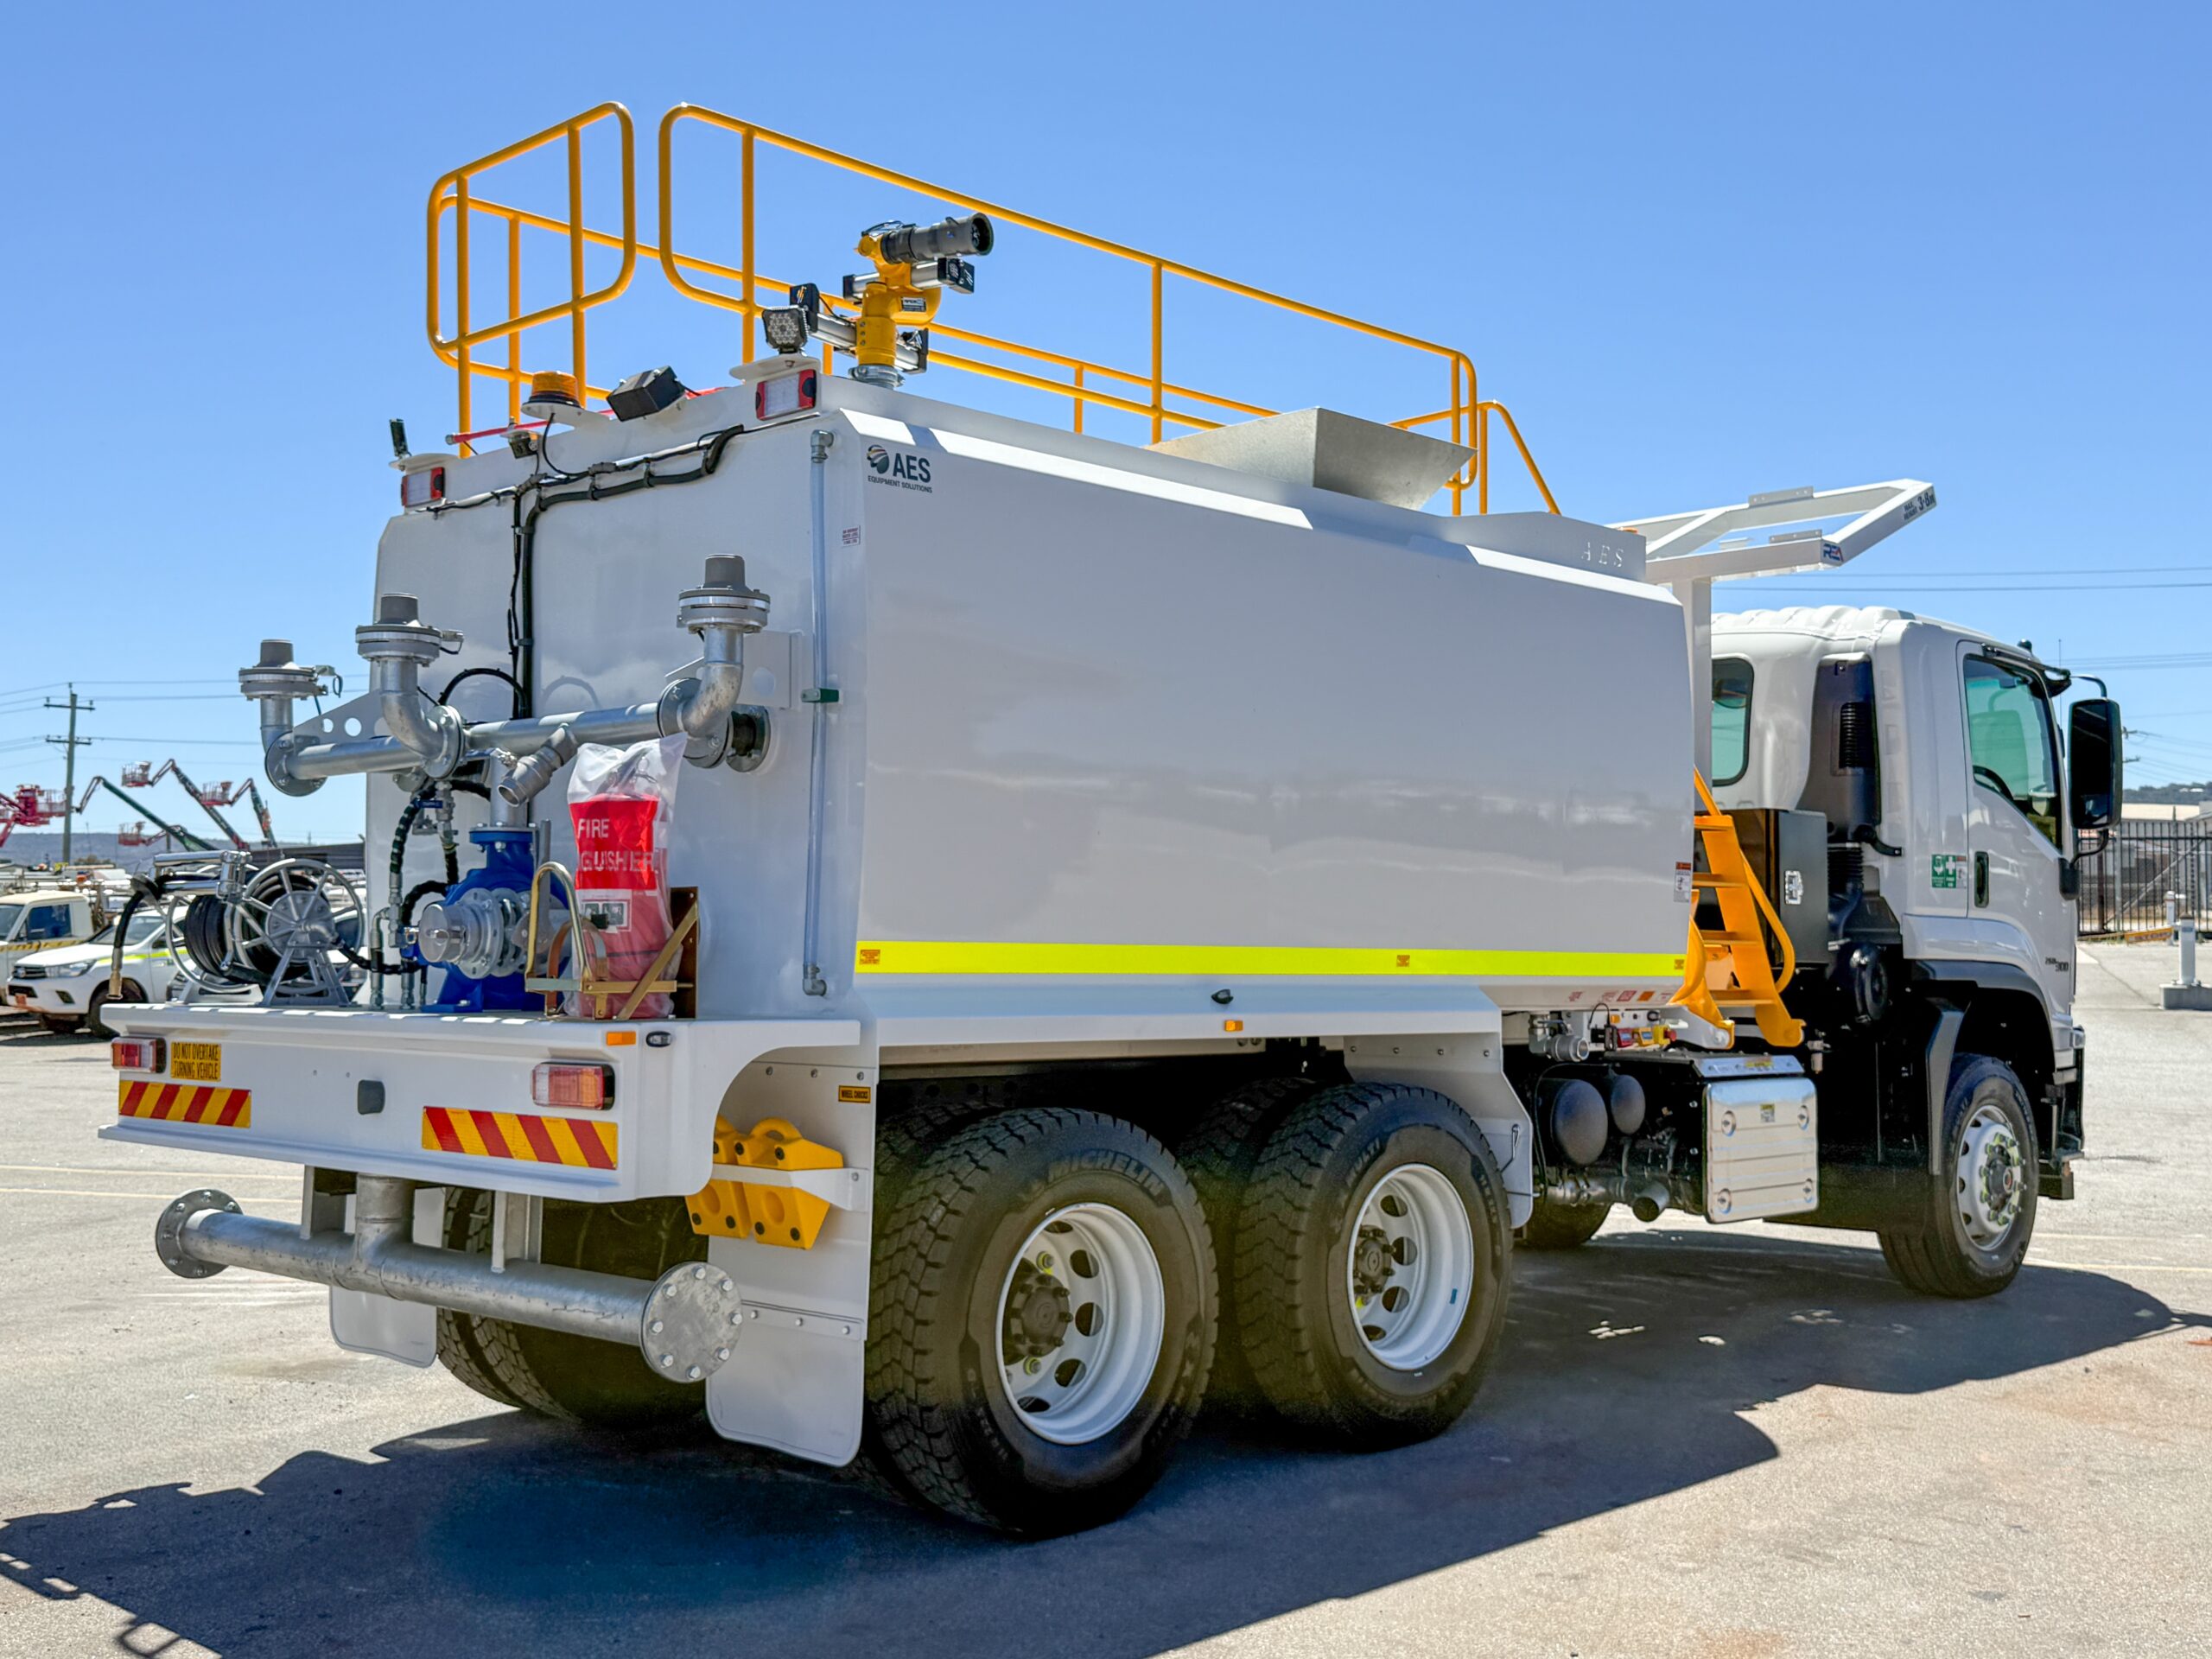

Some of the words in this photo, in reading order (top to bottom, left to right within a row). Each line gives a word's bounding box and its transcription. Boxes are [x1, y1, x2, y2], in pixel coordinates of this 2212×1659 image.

[893, 453, 931, 484] AES
[868, 475, 900, 487] EQUIPMENT
[901, 481, 932, 493] SOLUTIONS
[577, 818, 610, 840] FIRE
[174, 1042, 180, 1058] DO
[181, 1043, 191, 1059] NOT
[193, 1043, 219, 1062] OVERTAKE
[174, 1060, 195, 1079] TURNING
[197, 1062, 219, 1080] VEHICLE
[1047, 1149, 1165, 1197] MICHELIN
